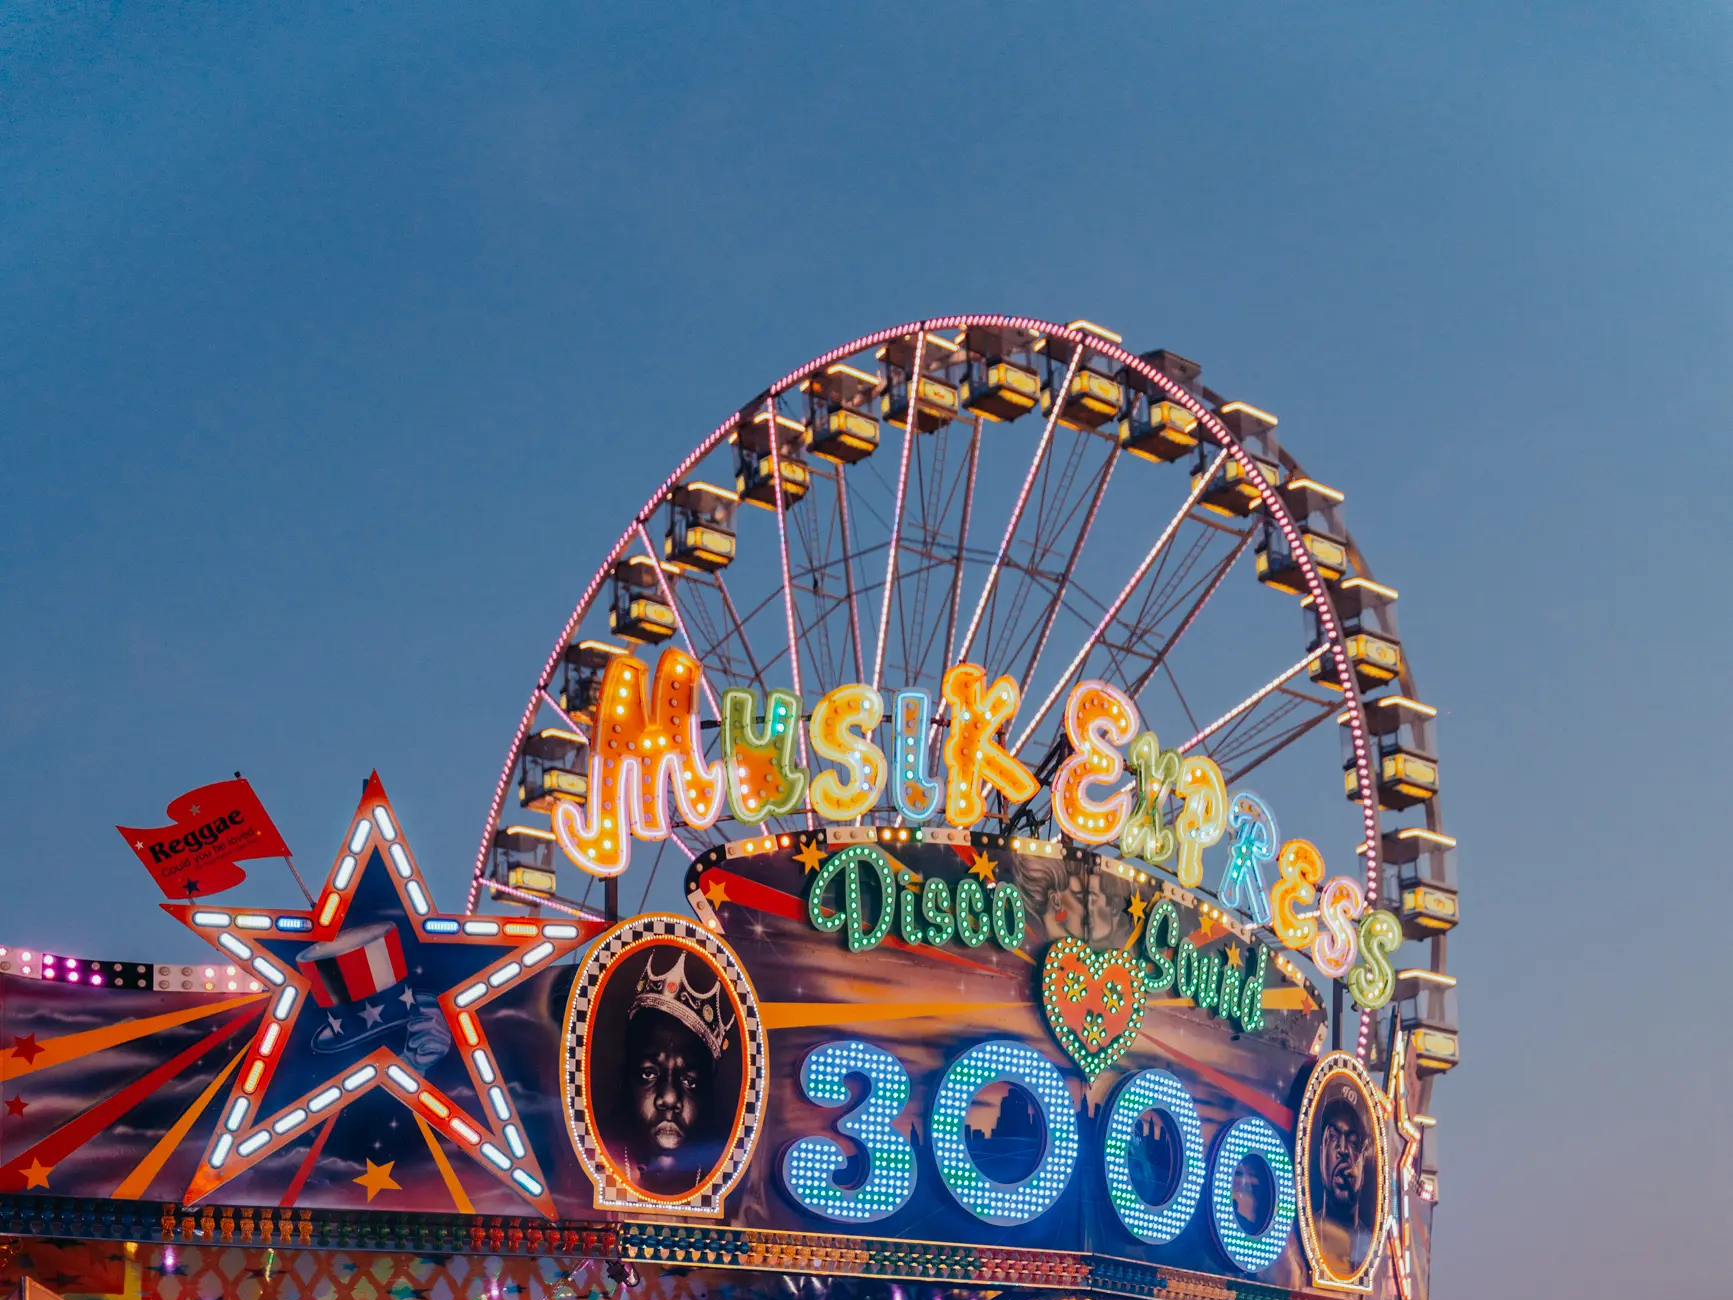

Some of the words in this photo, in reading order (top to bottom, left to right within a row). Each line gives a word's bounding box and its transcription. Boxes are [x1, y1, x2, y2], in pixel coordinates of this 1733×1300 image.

[149, 810, 244, 863] Reggae
[161, 857, 192, 878] Could
[193, 850, 212, 864] you
[212, 843, 226, 853] be
[227, 827, 255, 845] loved
[809, 846, 1027, 953] Disco
[1141, 898, 1269, 1033] Sound
[782, 1040, 1294, 1273] 3000
